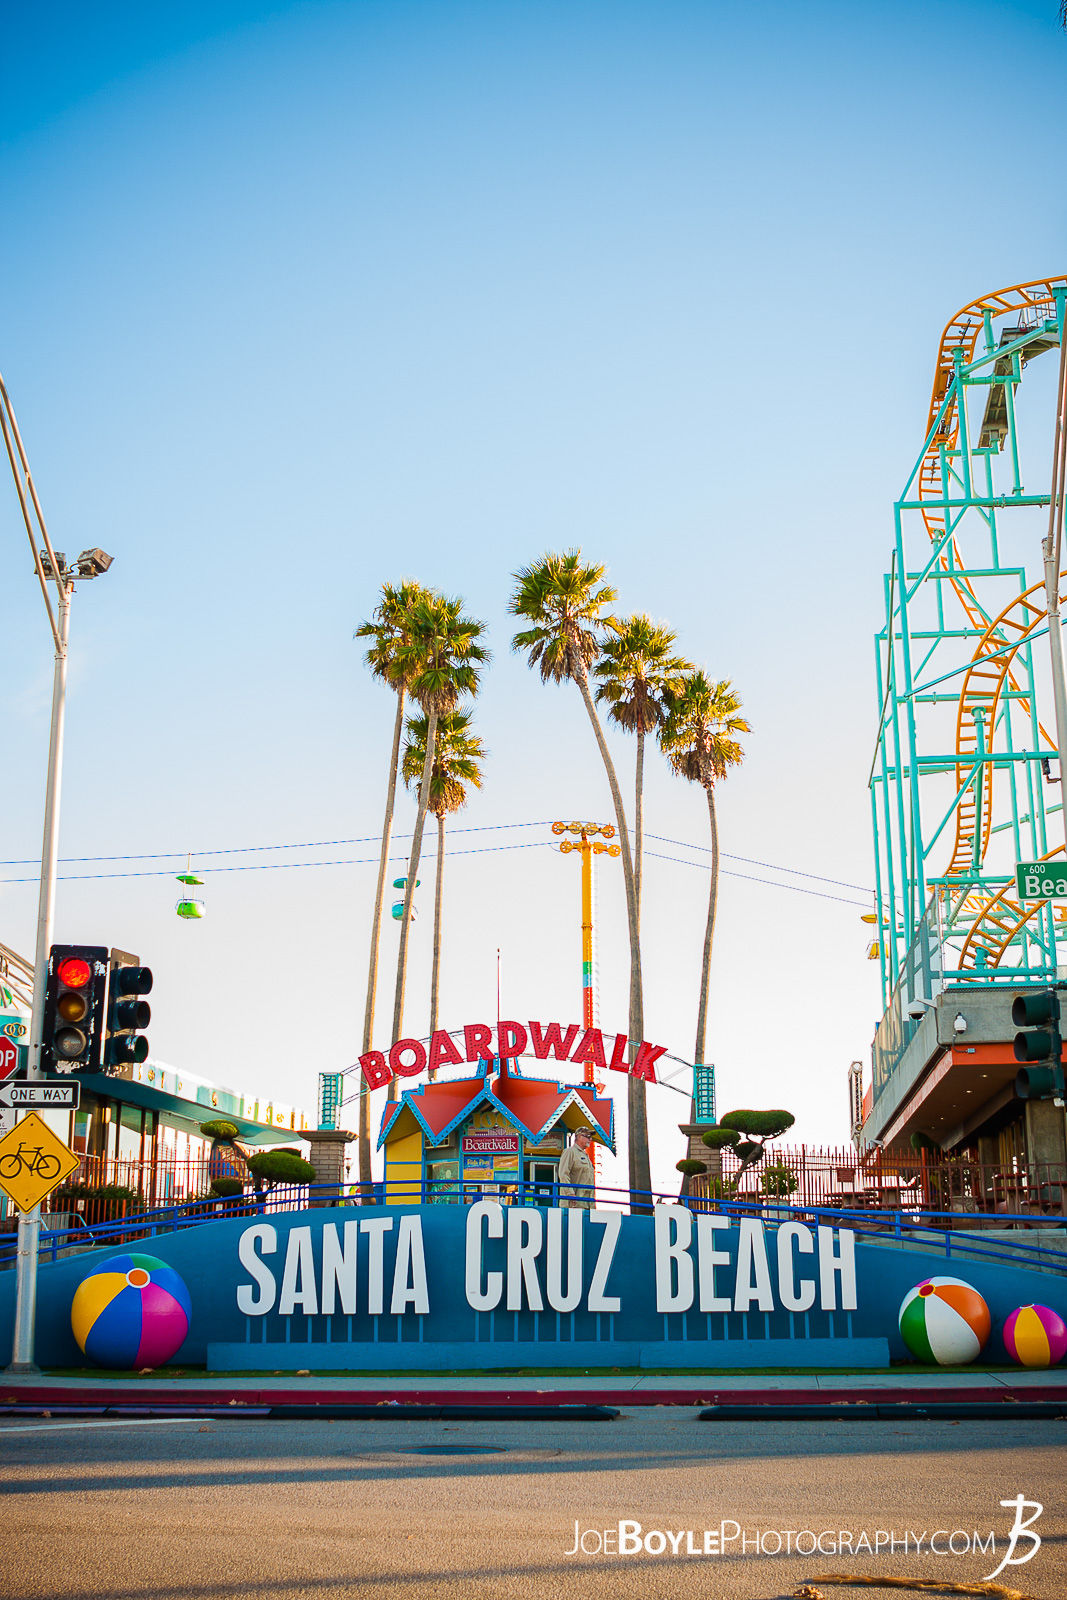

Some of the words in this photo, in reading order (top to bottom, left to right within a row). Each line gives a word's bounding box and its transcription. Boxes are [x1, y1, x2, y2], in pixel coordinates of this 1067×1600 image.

[1030, 865, 1045, 874] 600
[358, 1020, 669, 1091] BOARDWALK
[10, 1090, 36, 1100] ONE
[43, 1090, 70, 1100] WAY
[464, 1138, 516, 1150] Boardwalk
[236, 1214, 430, 1316] SANTA
[465, 1201, 623, 1313] CRUZ
[655, 1203, 857, 1314] BEACH
